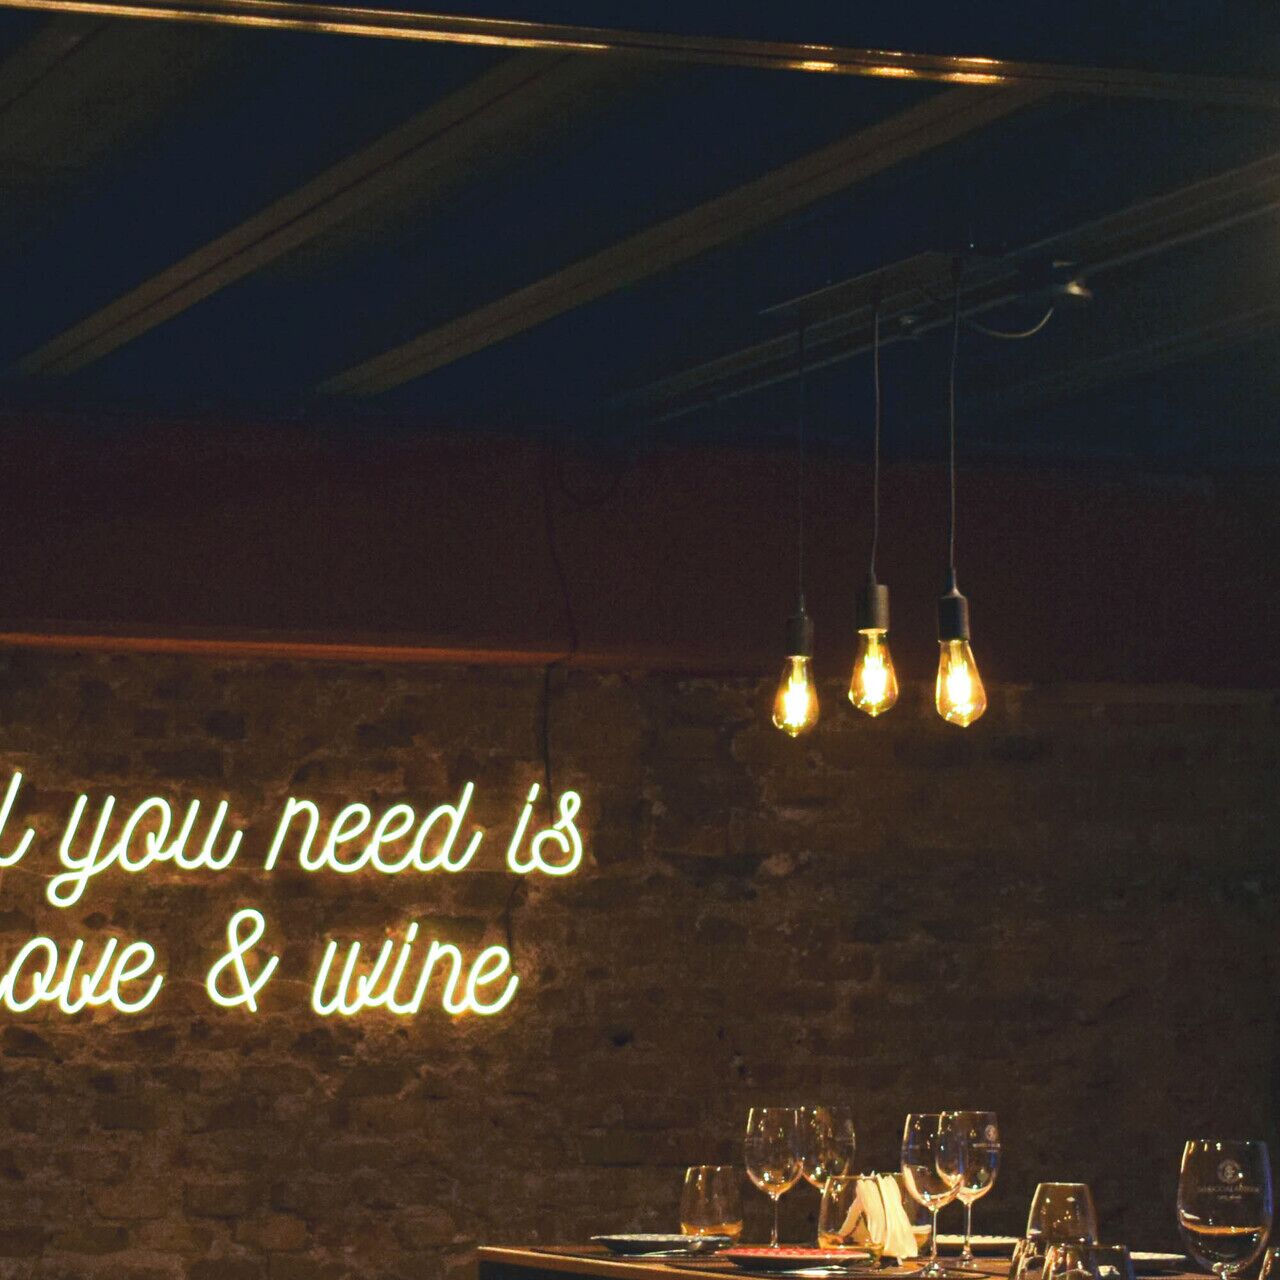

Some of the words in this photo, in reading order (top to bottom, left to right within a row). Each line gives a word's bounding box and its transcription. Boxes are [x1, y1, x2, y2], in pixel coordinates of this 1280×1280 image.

[46, 794, 243, 908] you
[264, 781, 483, 874] need
[506, 782, 584, 876] is
[205, 908, 280, 1013] &
[311, 922, 520, 1016] wine
